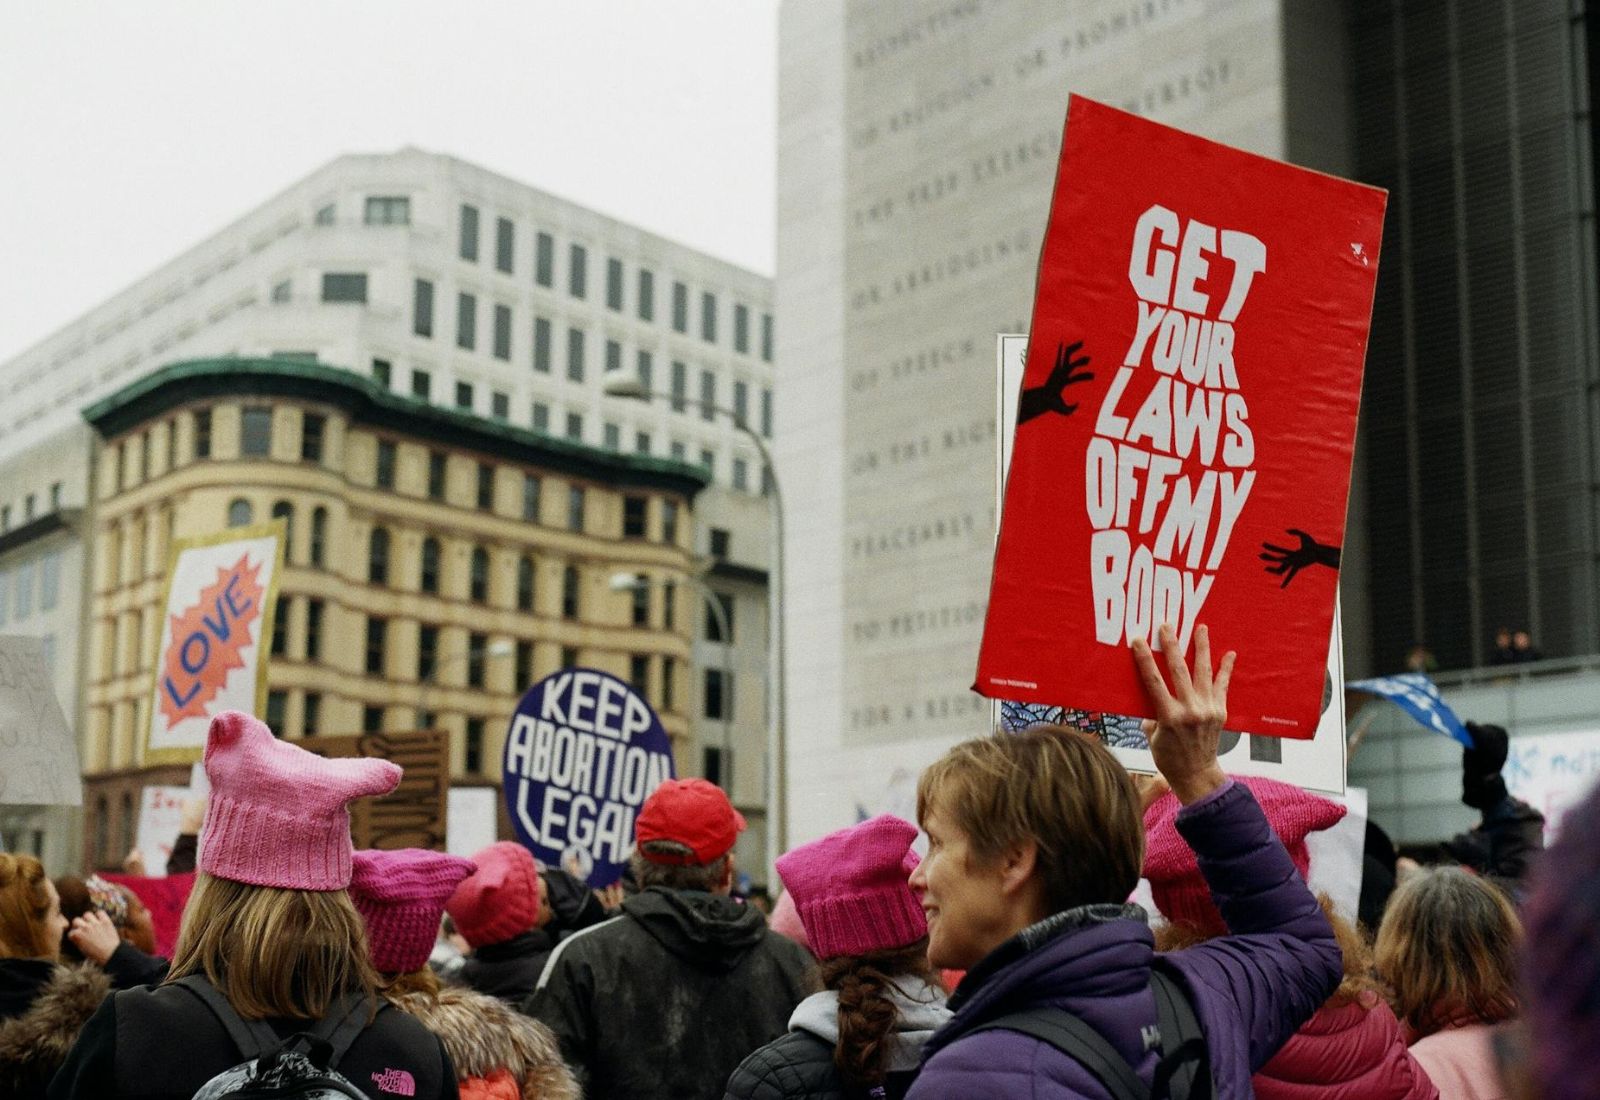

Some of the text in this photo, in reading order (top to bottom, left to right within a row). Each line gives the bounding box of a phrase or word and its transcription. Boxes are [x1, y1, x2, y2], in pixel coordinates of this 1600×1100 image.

[1129, 204, 1266, 323] GET
[1124, 300, 1240, 390] YOUR
[1095, 366, 1256, 468] LAWS
[1086, 437, 1257, 571] OFF MY
[1091, 529, 1215, 657] BODY
[164, 574, 251, 709] LOVE
[541, 671, 651, 743] KEEP
[507, 713, 671, 806] ABORTION
[371, 1071, 400, 1087] NORTH
[378, 1082, 401, 1093] FACE
[385, 1067, 401, 1079] THE
